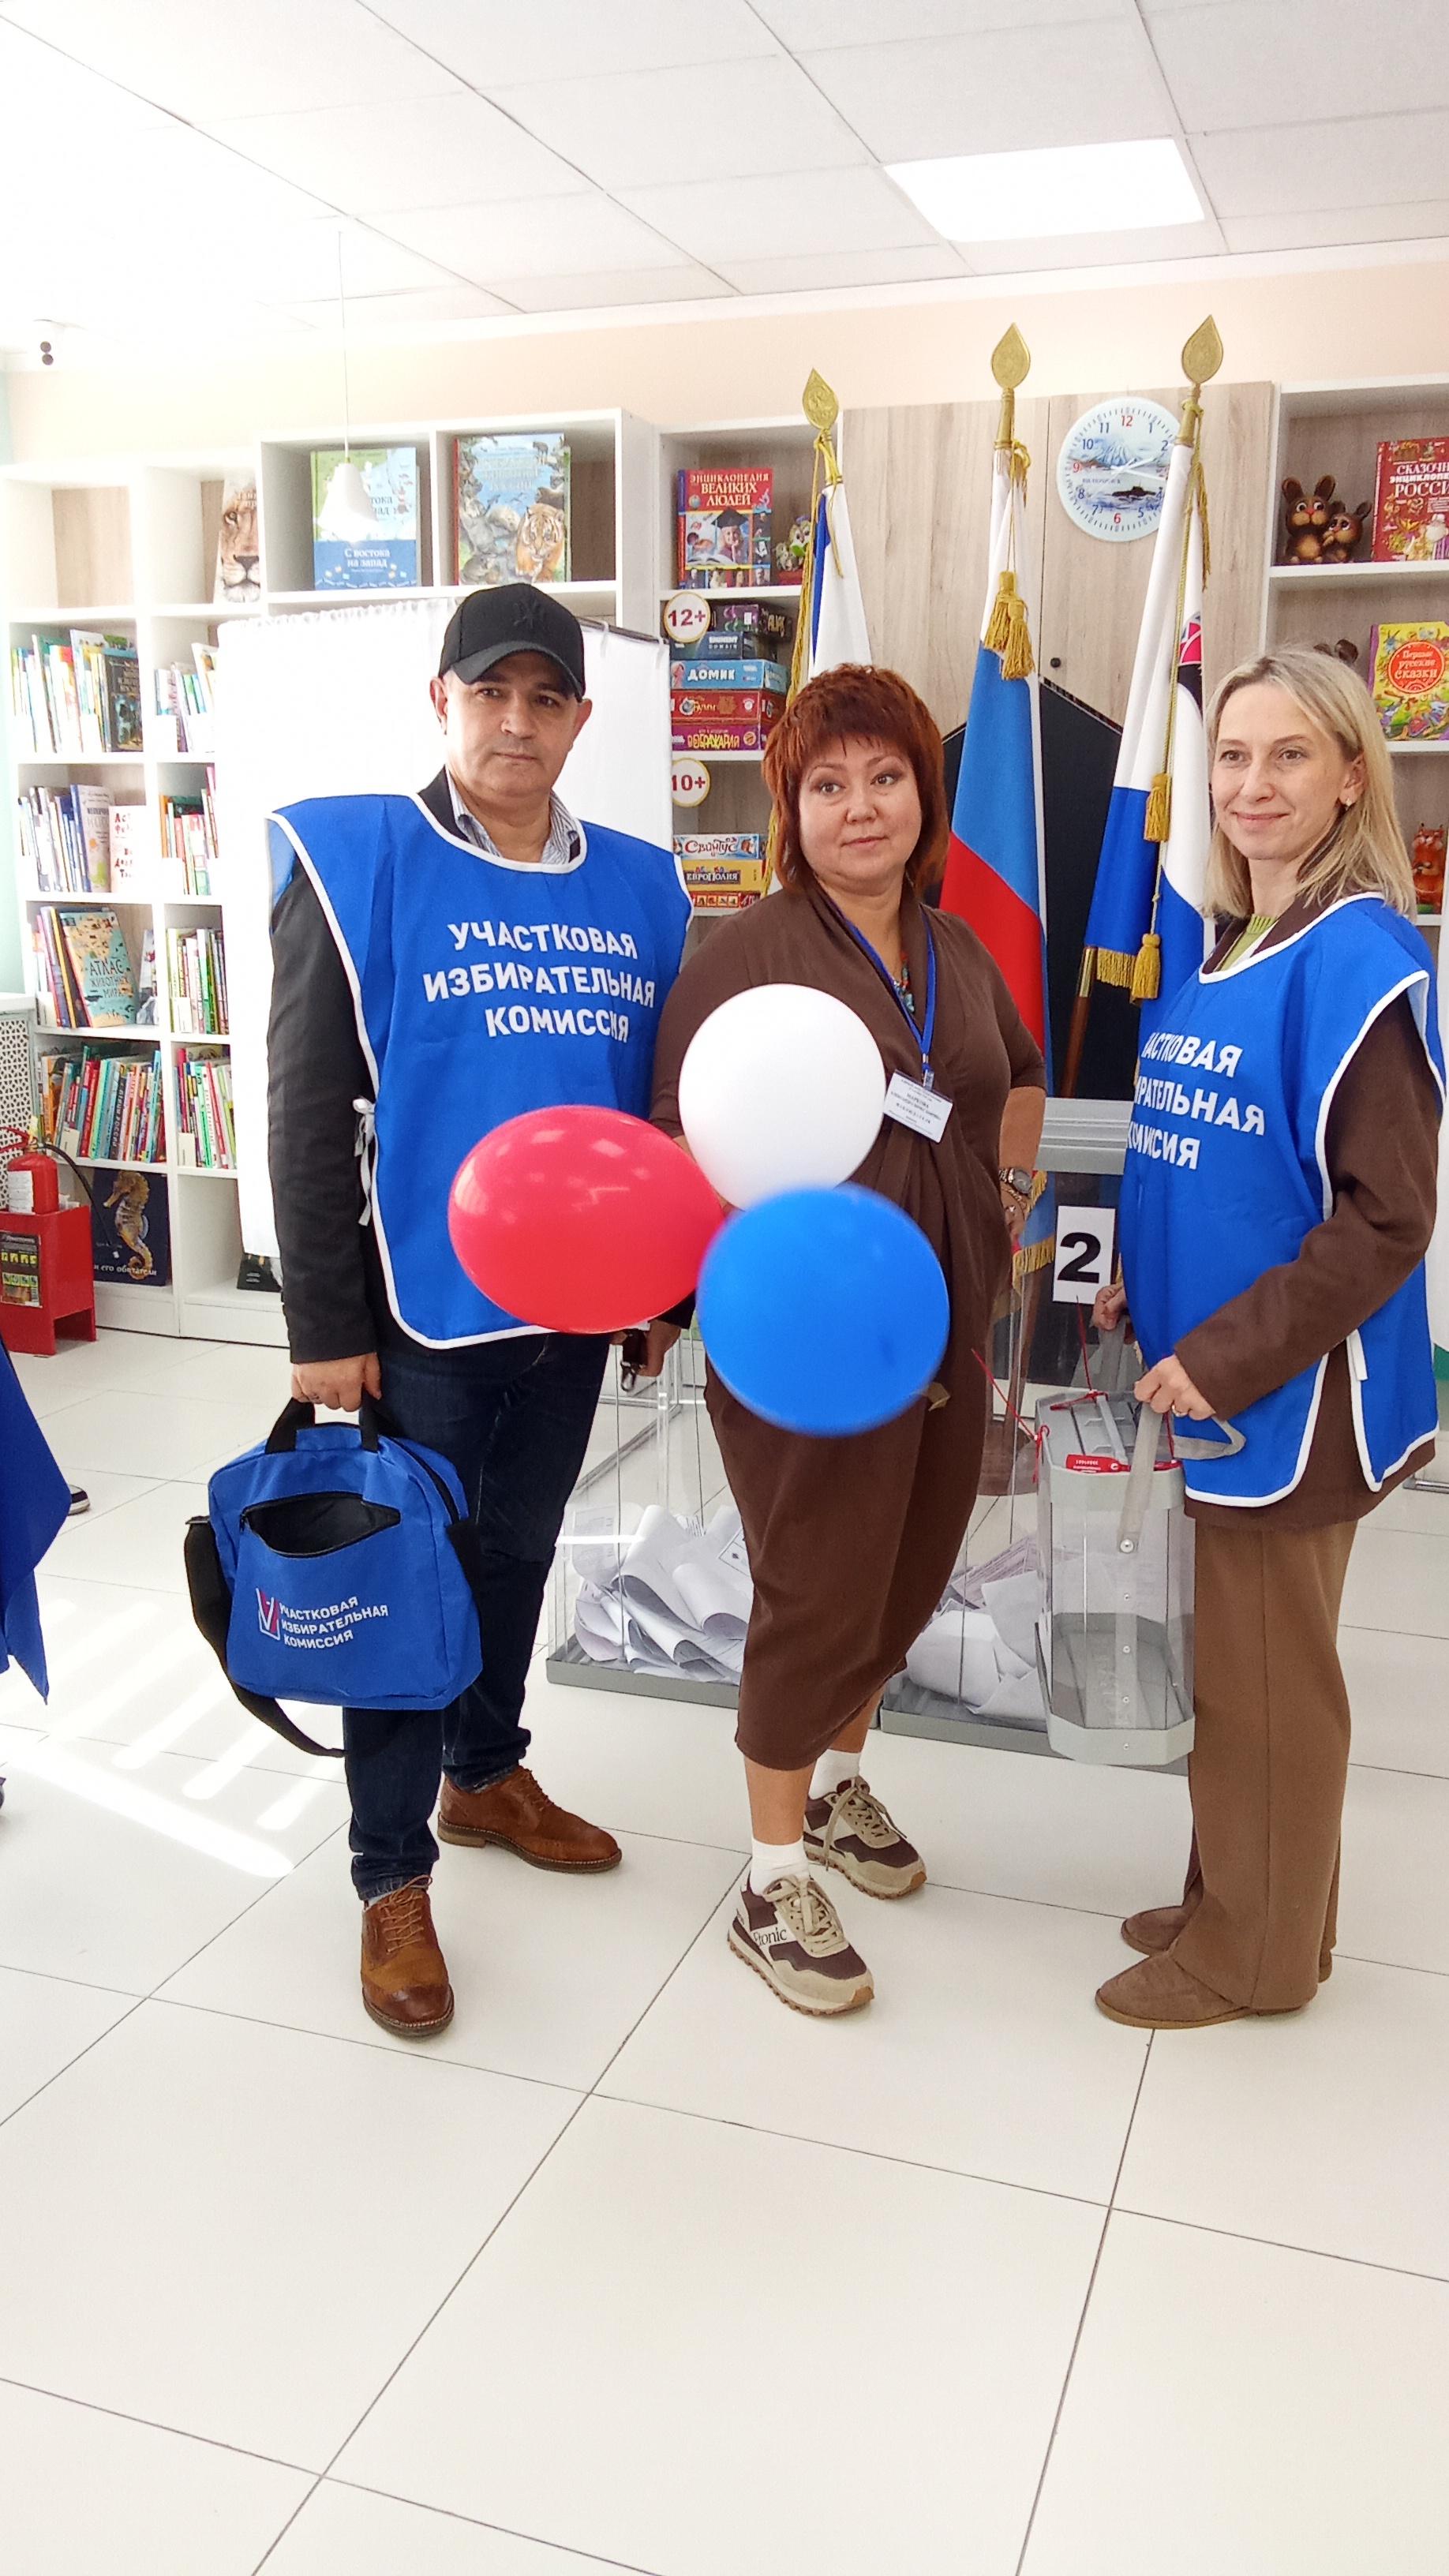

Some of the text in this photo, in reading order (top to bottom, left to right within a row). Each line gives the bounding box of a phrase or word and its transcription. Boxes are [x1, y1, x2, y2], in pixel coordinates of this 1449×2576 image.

[1121, 415, 1133, 427] 12
[1099, 422, 1110, 433] 11
[1148, 422, 1153, 434] 1
[1082, 439, 1094, 450] 10
[1161, 440, 1169, 451] 2
[1073, 462, 1080, 474] 9
[690, 473, 769, 484] ЭНЦИКЛОПЕДИЯ
[702, 482, 758, 494] ВЕЛИКИХ
[1078, 488, 1085, 500] 8
[706, 492, 751, 507] ЛЮДЕЙ
[1156, 490, 1165, 501] 4
[1092, 504, 1099, 515] 7
[1137, 507, 1144, 519] 5
[1114, 512, 1121, 524] 6
[668, 608, 706, 627] 12+
[687, 668, 736, 681] ДОМИК
[672, 774, 706, 792] 10+
[686, 872, 738, 882] ЕВРОПОЛИЯ
[447, 920, 639, 960] УЧАСТКОВАЯ
[89, 959, 125, 977] АТЛАС
[422, 962, 655, 1009] ИЗБИРАТЕЛЬНАЯ
[485, 1005, 629, 1043] КОМИССИЯ
[1057, 1232, 1101, 1283] 2
[279, 1596, 359, 1621] УЧАСТКОВАЯ
[281, 1604, 389, 1635] ИЗБИРАТЕЛЬНАЯ
[283, 1629, 354, 1649] КОМИССИЯ
